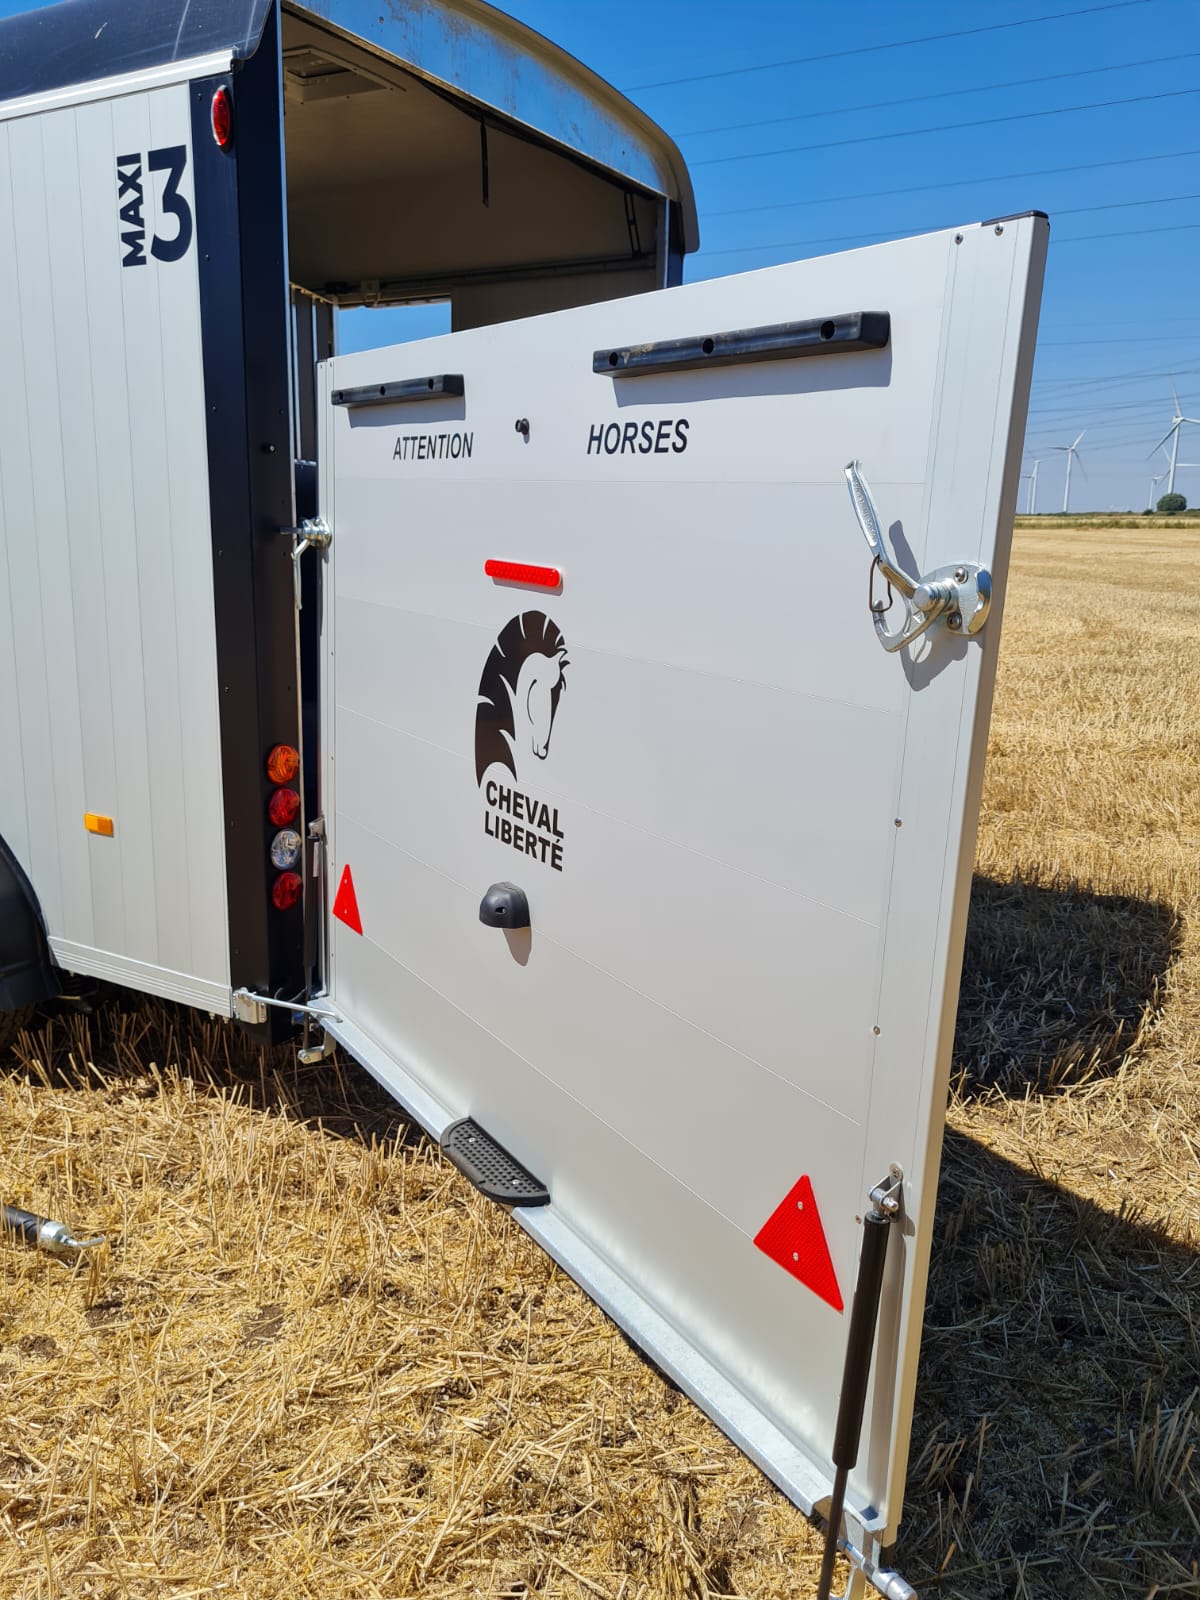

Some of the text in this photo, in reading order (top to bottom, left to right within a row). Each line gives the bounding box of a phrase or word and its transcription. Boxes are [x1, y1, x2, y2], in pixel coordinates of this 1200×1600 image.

[116, 152, 147, 267] MAXI
[148, 145, 192, 262] 3
[392, 418, 690, 461] ATTENTION HORSES
[485, 780, 565, 839] CHEVAL
[484, 810, 564, 872] LIBERTÉ
